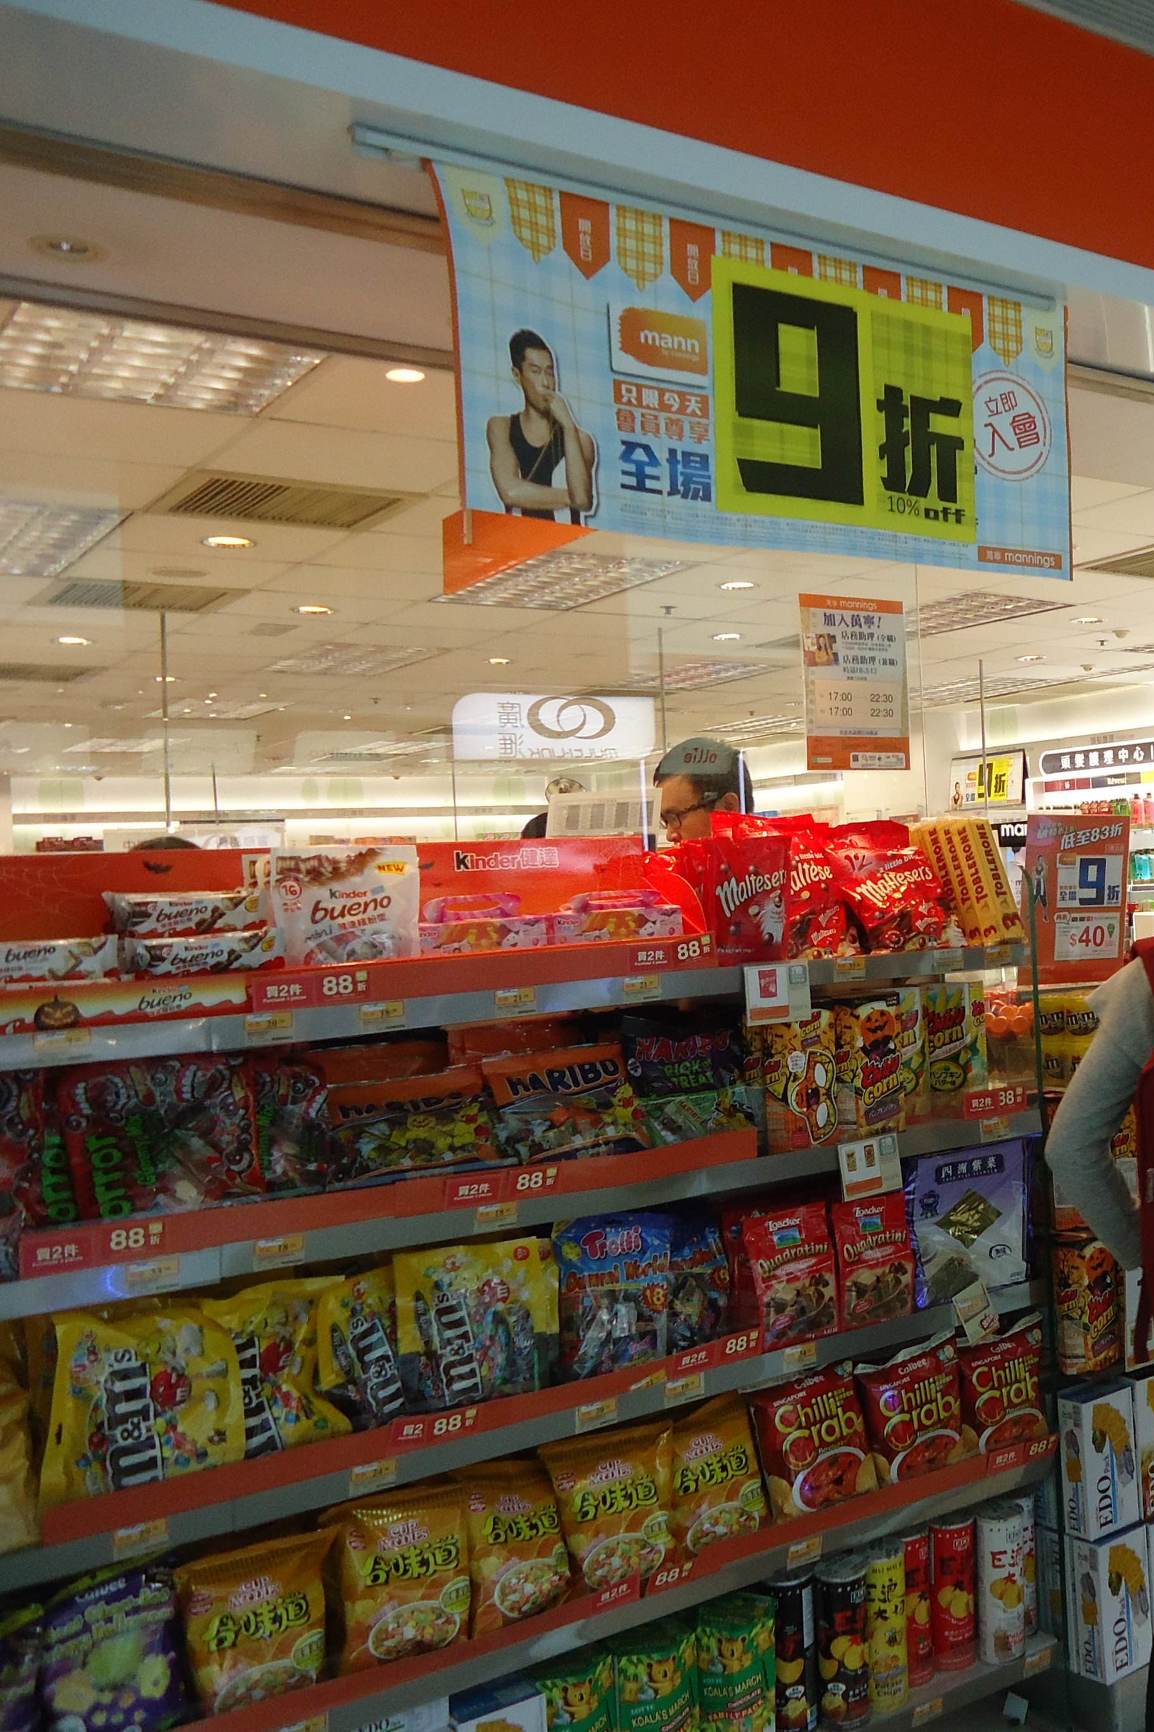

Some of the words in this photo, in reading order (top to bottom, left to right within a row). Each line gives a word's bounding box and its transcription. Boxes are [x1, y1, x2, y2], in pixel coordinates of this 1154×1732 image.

[620, 383, 703, 416] 只限今天
[732, 282, 865, 506] 9
[984, 390, 1018, 417] 立即
[616, 408, 710, 444] 會員尊享
[984, 412, 1040, 459] 入會
[876, 384, 965, 504] 折
[619, 440, 712, 503] 全場
[887, 496, 920, 518] 10%
[924, 506, 966, 525] off
[1004, 550, 1056, 567] mannings
[828, 692, 853, 703] 17:00
[870, 692, 894, 704] 22:30
[828, 707, 853, 718] 17:00
[870, 707, 894, 718] 22:30
[957, 826, 990, 905] TOBLERONE
[976, 823, 1008, 899] TOBLERONE
[1079, 858, 1106, 906] 9
[155, 904, 208, 923] bueno
[310, 895, 392, 926] bueno
[677, 940, 701, 961] 88
[1069, 924, 1105, 948] $40
[4, 945, 57, 964] bueno
[170, 949, 225, 967] bueno
[137, 991, 193, 1012] bueno
[321, 974, 353, 996] 88
[504, 1059, 621, 1098] HARIBO
[515, 1171, 543, 1192] 88
[767, 1216, 801, 1232] Loacker
[854, 1205, 886, 1218] Loacker
[110, 1227, 145, 1251] 88
[581, 1225, 643, 1260] Trolli
[843, 1229, 907, 1263] Quadratini
[757, 1241, 830, 1278] Quadratini
[725, 1336, 749, 1355] 88
[897, 1357, 929, 1376] Calbee
[971, 1358, 1026, 1391] Chilli
[879, 1377, 938, 1418] Chilli
[433, 1414, 463, 1437] 88
[774, 1395, 838, 1435] Chilli
[883, 1391, 961, 1452] Crab
[782, 1407, 864, 1472] Crab
[673, 1444, 749, 1496] 合味道
[572, 1474, 659, 1522] 合味道
[1096, 1474, 1114, 1530] EDO
[377, 1525, 431, 1552] NOODLES
[388, 1520, 420, 1537] CUP
[481, 1505, 561, 1546] 合味道
[359, 1534, 461, 1588] 合味道
[654, 1567, 680, 1588] 88
[202, 1591, 310, 1652] 合味道
[1112, 1616, 1129, 1673] EDO
[734, 1672, 762, 1697] MARCH
[630, 1711, 668, 1729] KOALA'S
[667, 1690, 691, 1718] MARCH
